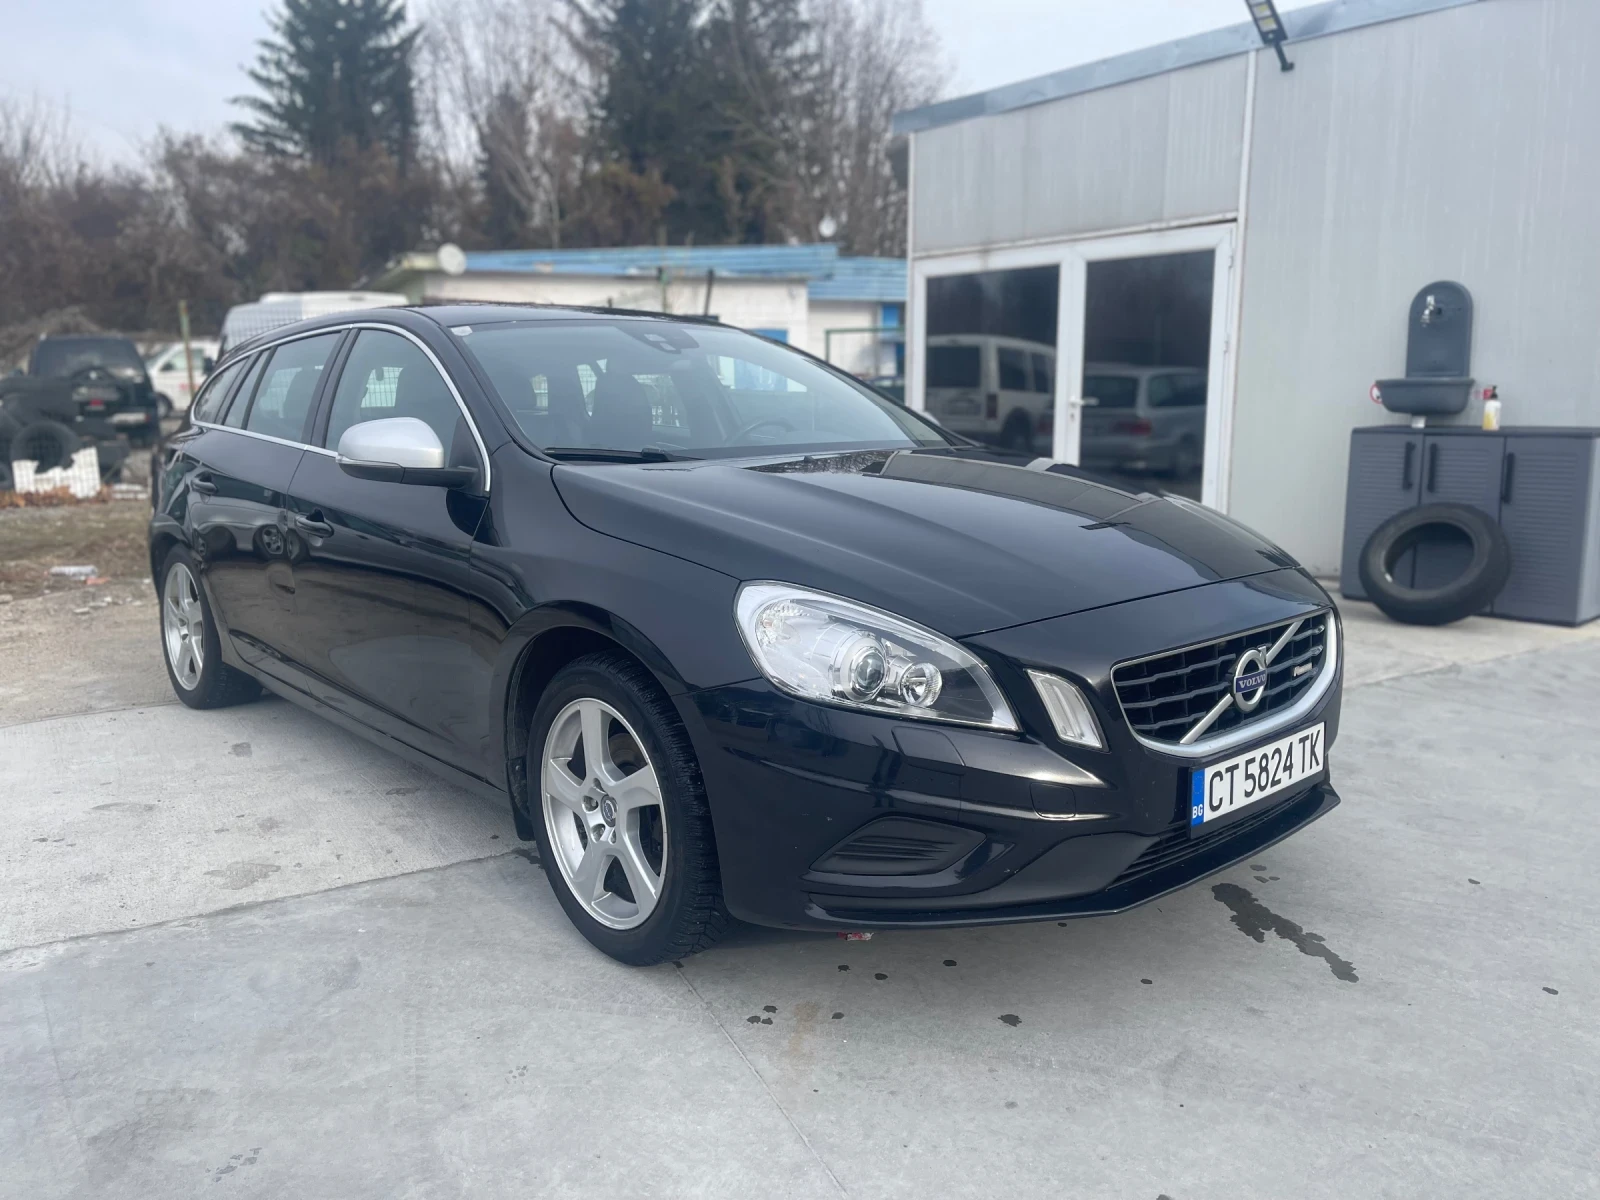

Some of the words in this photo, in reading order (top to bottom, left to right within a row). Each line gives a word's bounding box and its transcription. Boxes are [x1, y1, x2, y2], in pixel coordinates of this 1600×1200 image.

[1238, 674, 1266, 688] VOLVO
[1209, 763, 1239, 812] CT
[1244, 741, 1294, 798] 5824
[1299, 729, 1321, 773] TK
[1192, 803, 1203, 818] BG
